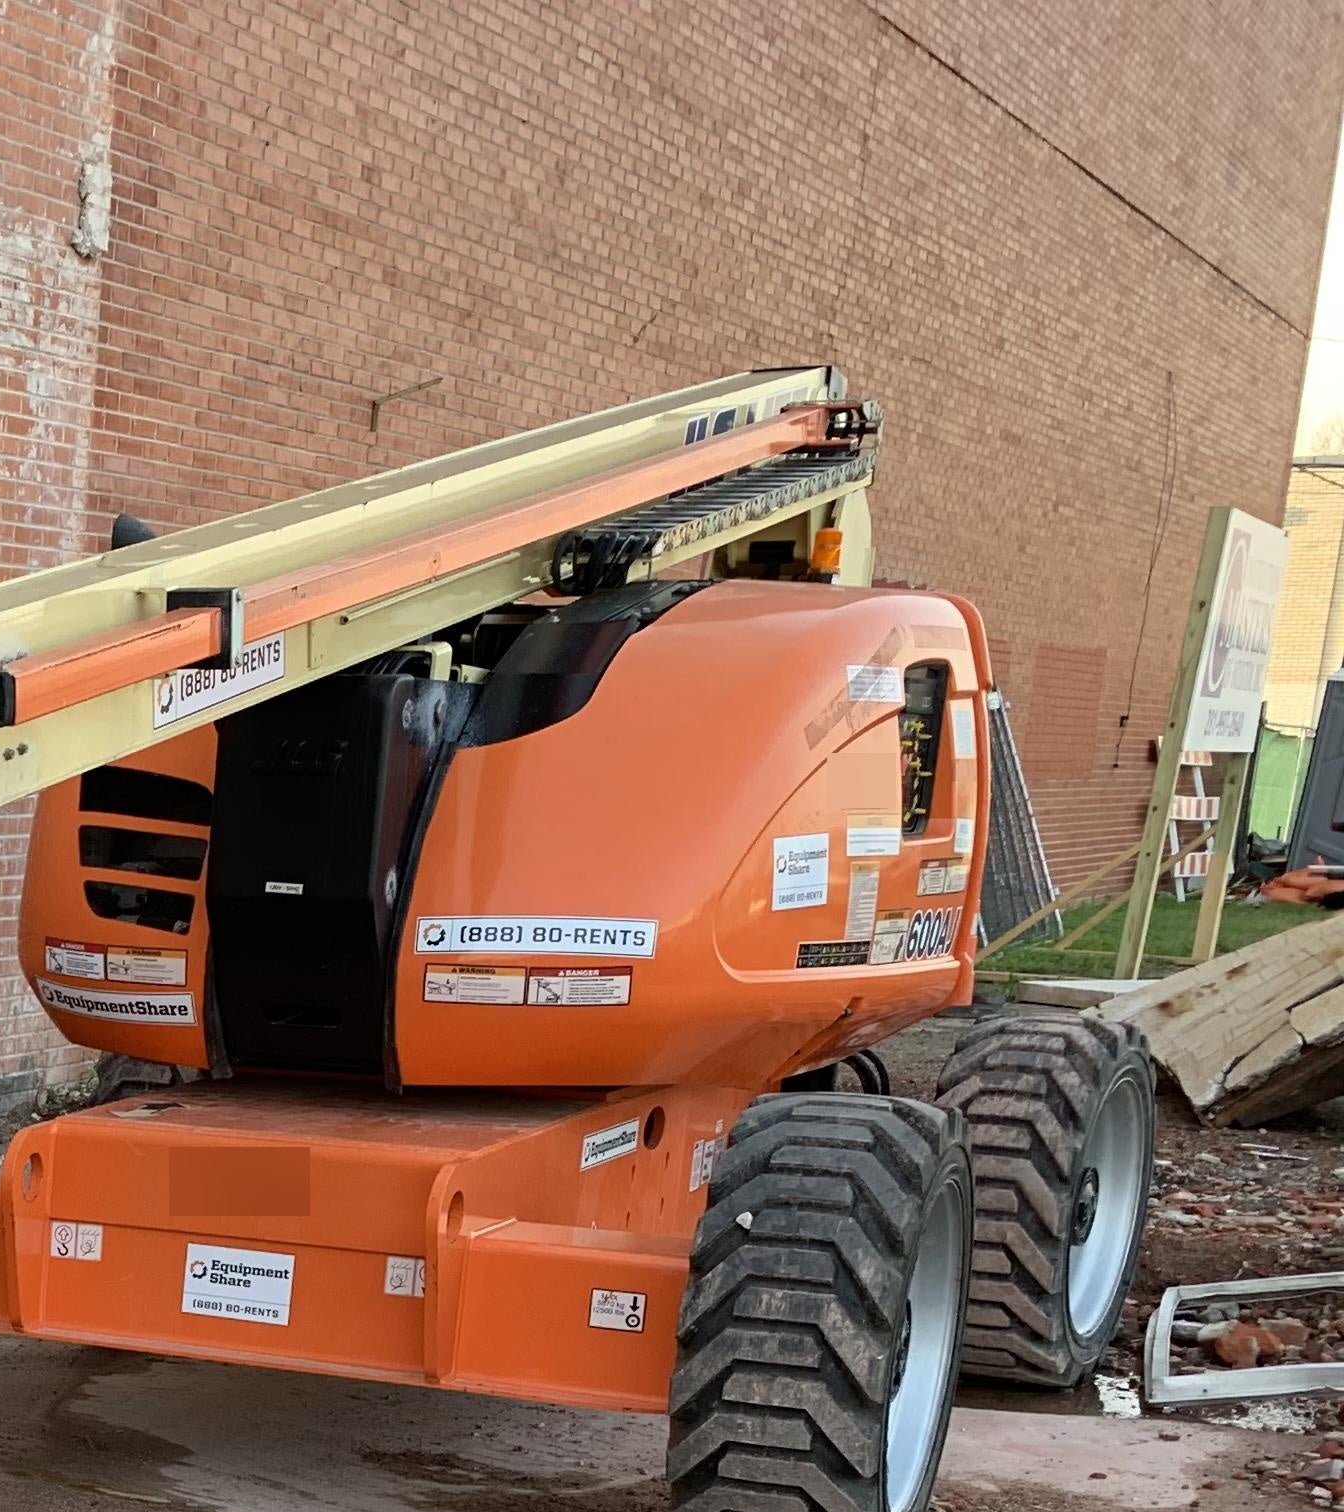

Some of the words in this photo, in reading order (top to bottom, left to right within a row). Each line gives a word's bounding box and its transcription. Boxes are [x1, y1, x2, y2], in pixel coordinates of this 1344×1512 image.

[788, 849, 827, 864] Equipment
[788, 865, 810, 875] Share
[460, 925, 523, 944] (888)
[532, 927, 646, 947] 80-RENTS
[905, 906, 963, 961] 600AJ
[54, 989, 188, 1016] EquipmentShare
[209, 1273, 251, 1288] Share
[211, 1259, 290, 1281] Equipment
[192, 1299, 223, 1312] (888)
[226, 1304, 279, 1319] 80-RENTS
